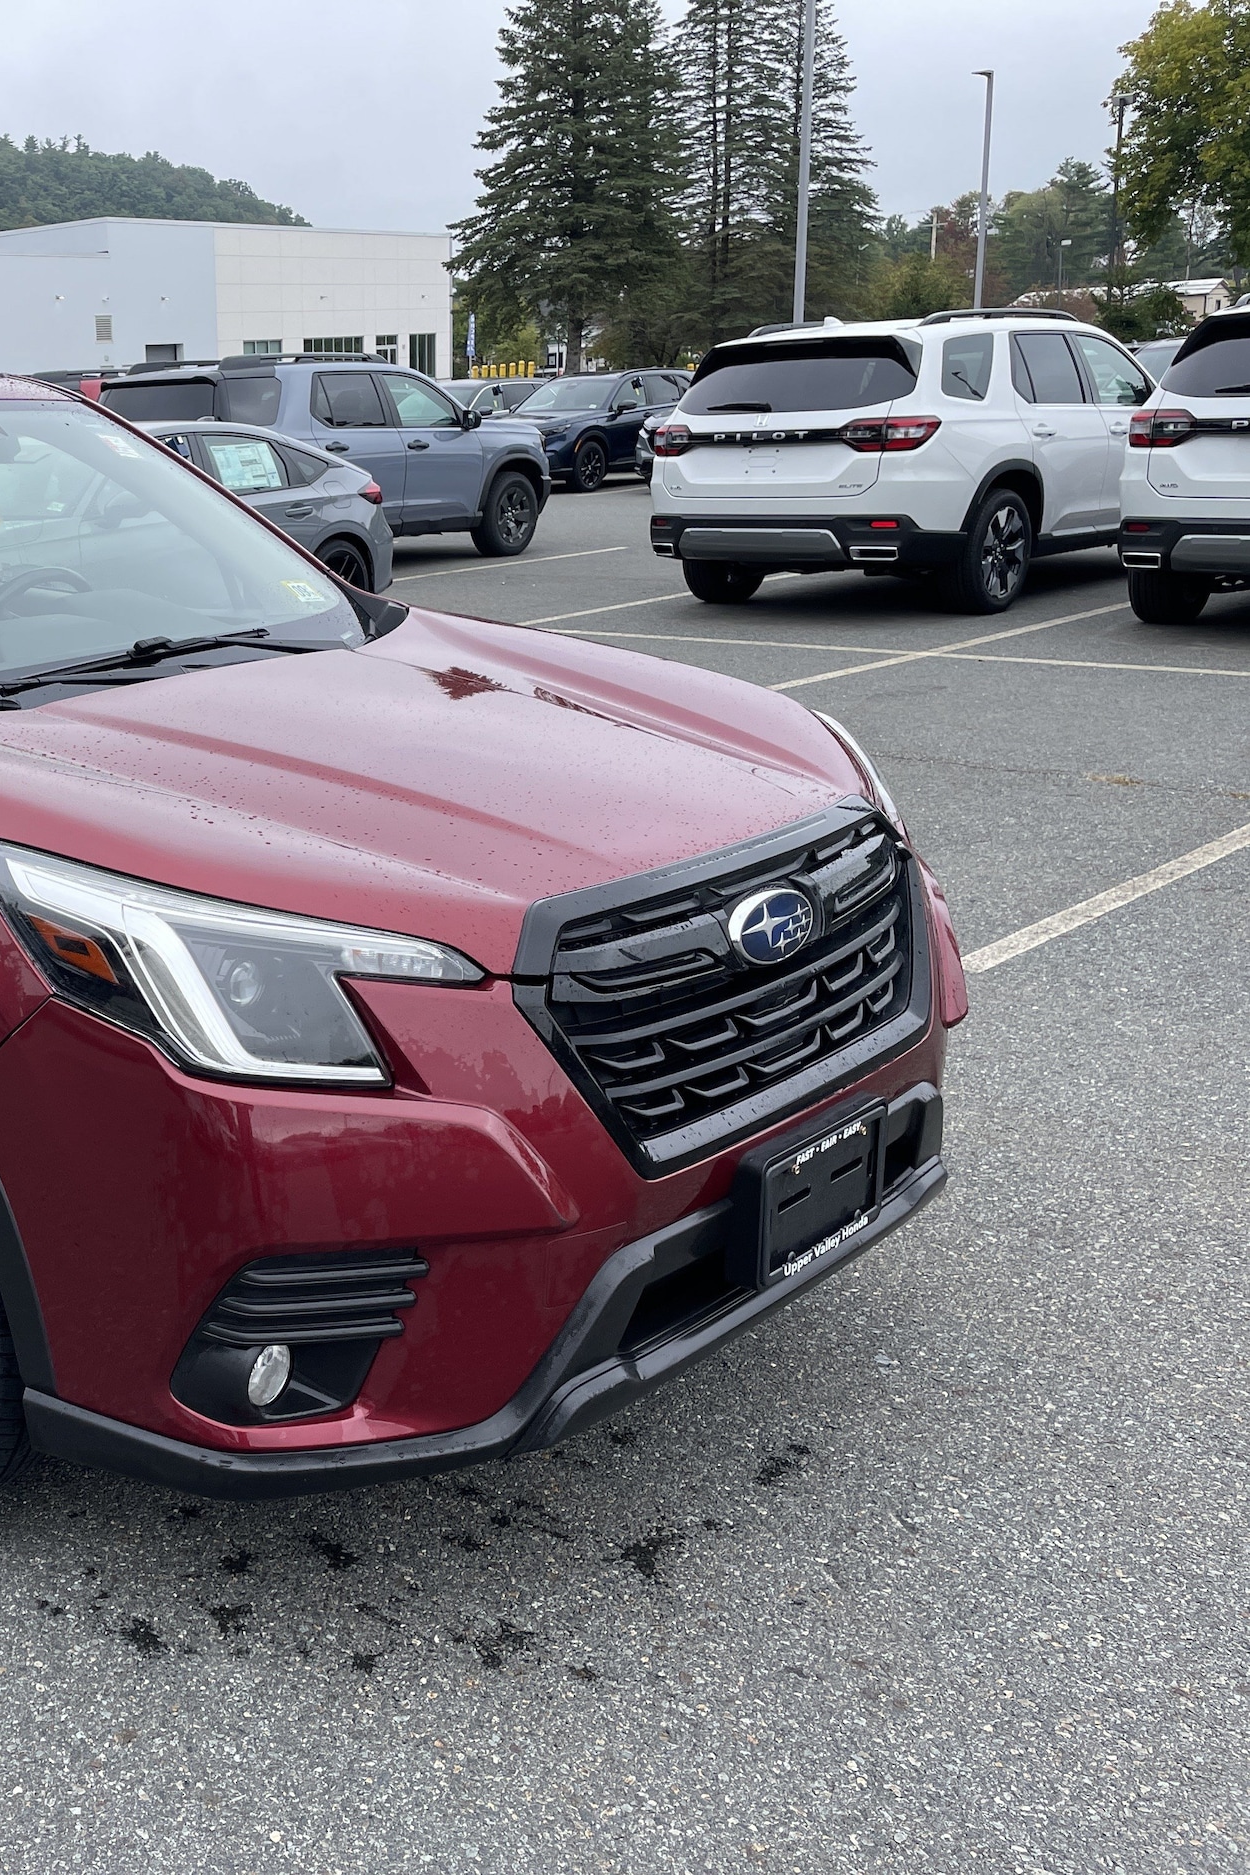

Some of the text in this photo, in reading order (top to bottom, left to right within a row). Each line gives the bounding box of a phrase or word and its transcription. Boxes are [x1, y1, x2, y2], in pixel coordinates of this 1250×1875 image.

[713, 430, 809, 442] PILOT
[796, 1121, 862, 1166] FAST FAIR EASY
[783, 1215, 869, 1277] Upper Valley Honda
